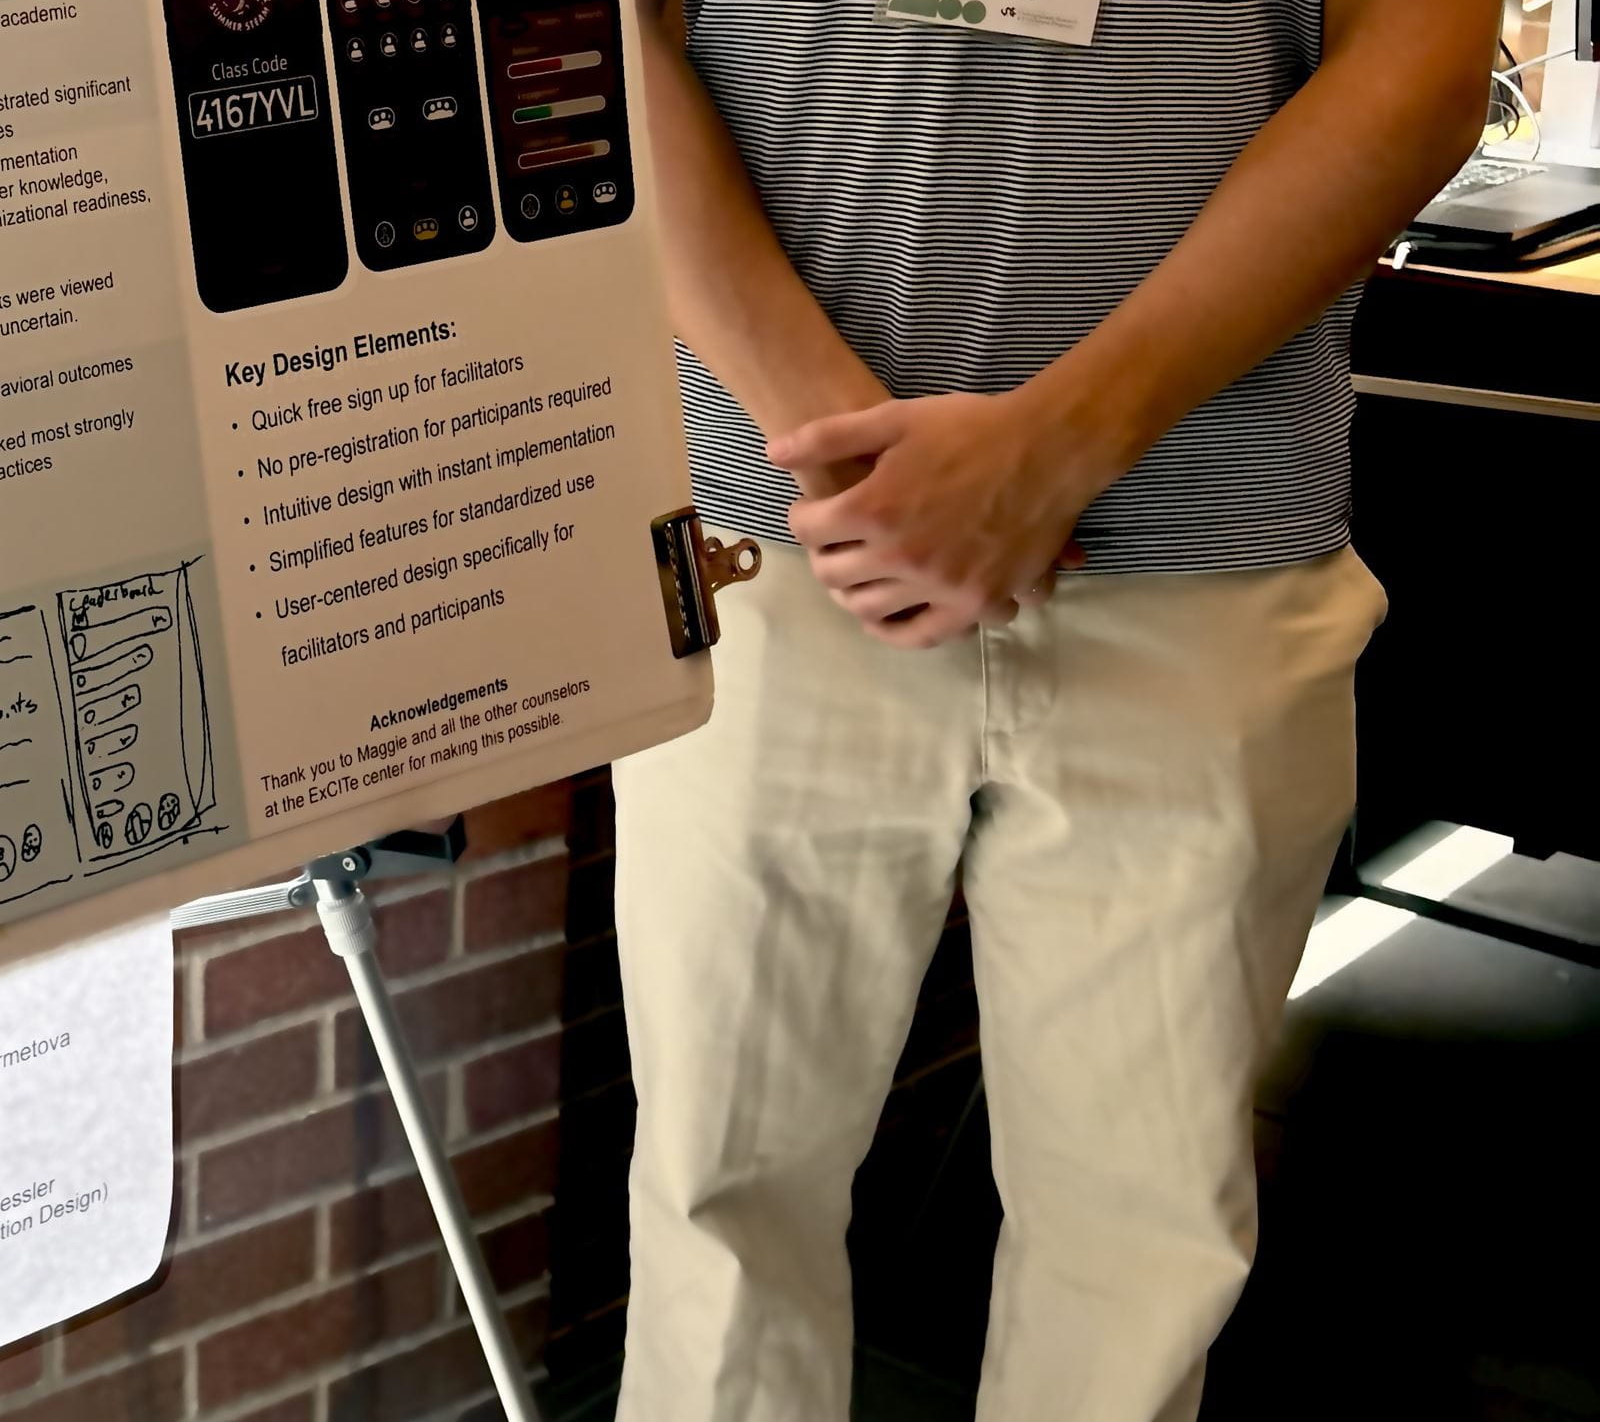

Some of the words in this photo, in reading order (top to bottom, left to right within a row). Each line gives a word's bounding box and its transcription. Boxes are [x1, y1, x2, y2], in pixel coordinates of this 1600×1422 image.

[211, 61, 249, 82] Class
[252, 56, 288, 77] Code
[196, 84, 315, 132] 4167YVL
[226, 362, 265, 387] Key
[273, 345, 347, 376] Design
[354, 321, 456, 358] Elements:
[252, 403, 303, 430] Quick
[308, 398, 342, 418] free
[347, 388, 383, 411] sign
[388, 382, 409, 402] up
[414, 374, 436, 394] for
[441, 356, 523, 387] facilitators
[371, 679, 508, 731] Acknowledgements
[265, 801, 279, 818] at
[282, 796, 304, 812] the
[309, 776, 358, 804] ExCITe
[363, 763, 404, 786] center
[409, 756, 425, 771] for
[430, 740, 478, 764] making
[481, 731, 504, 748] this
[40, 1183, 107, 1224] Design)
